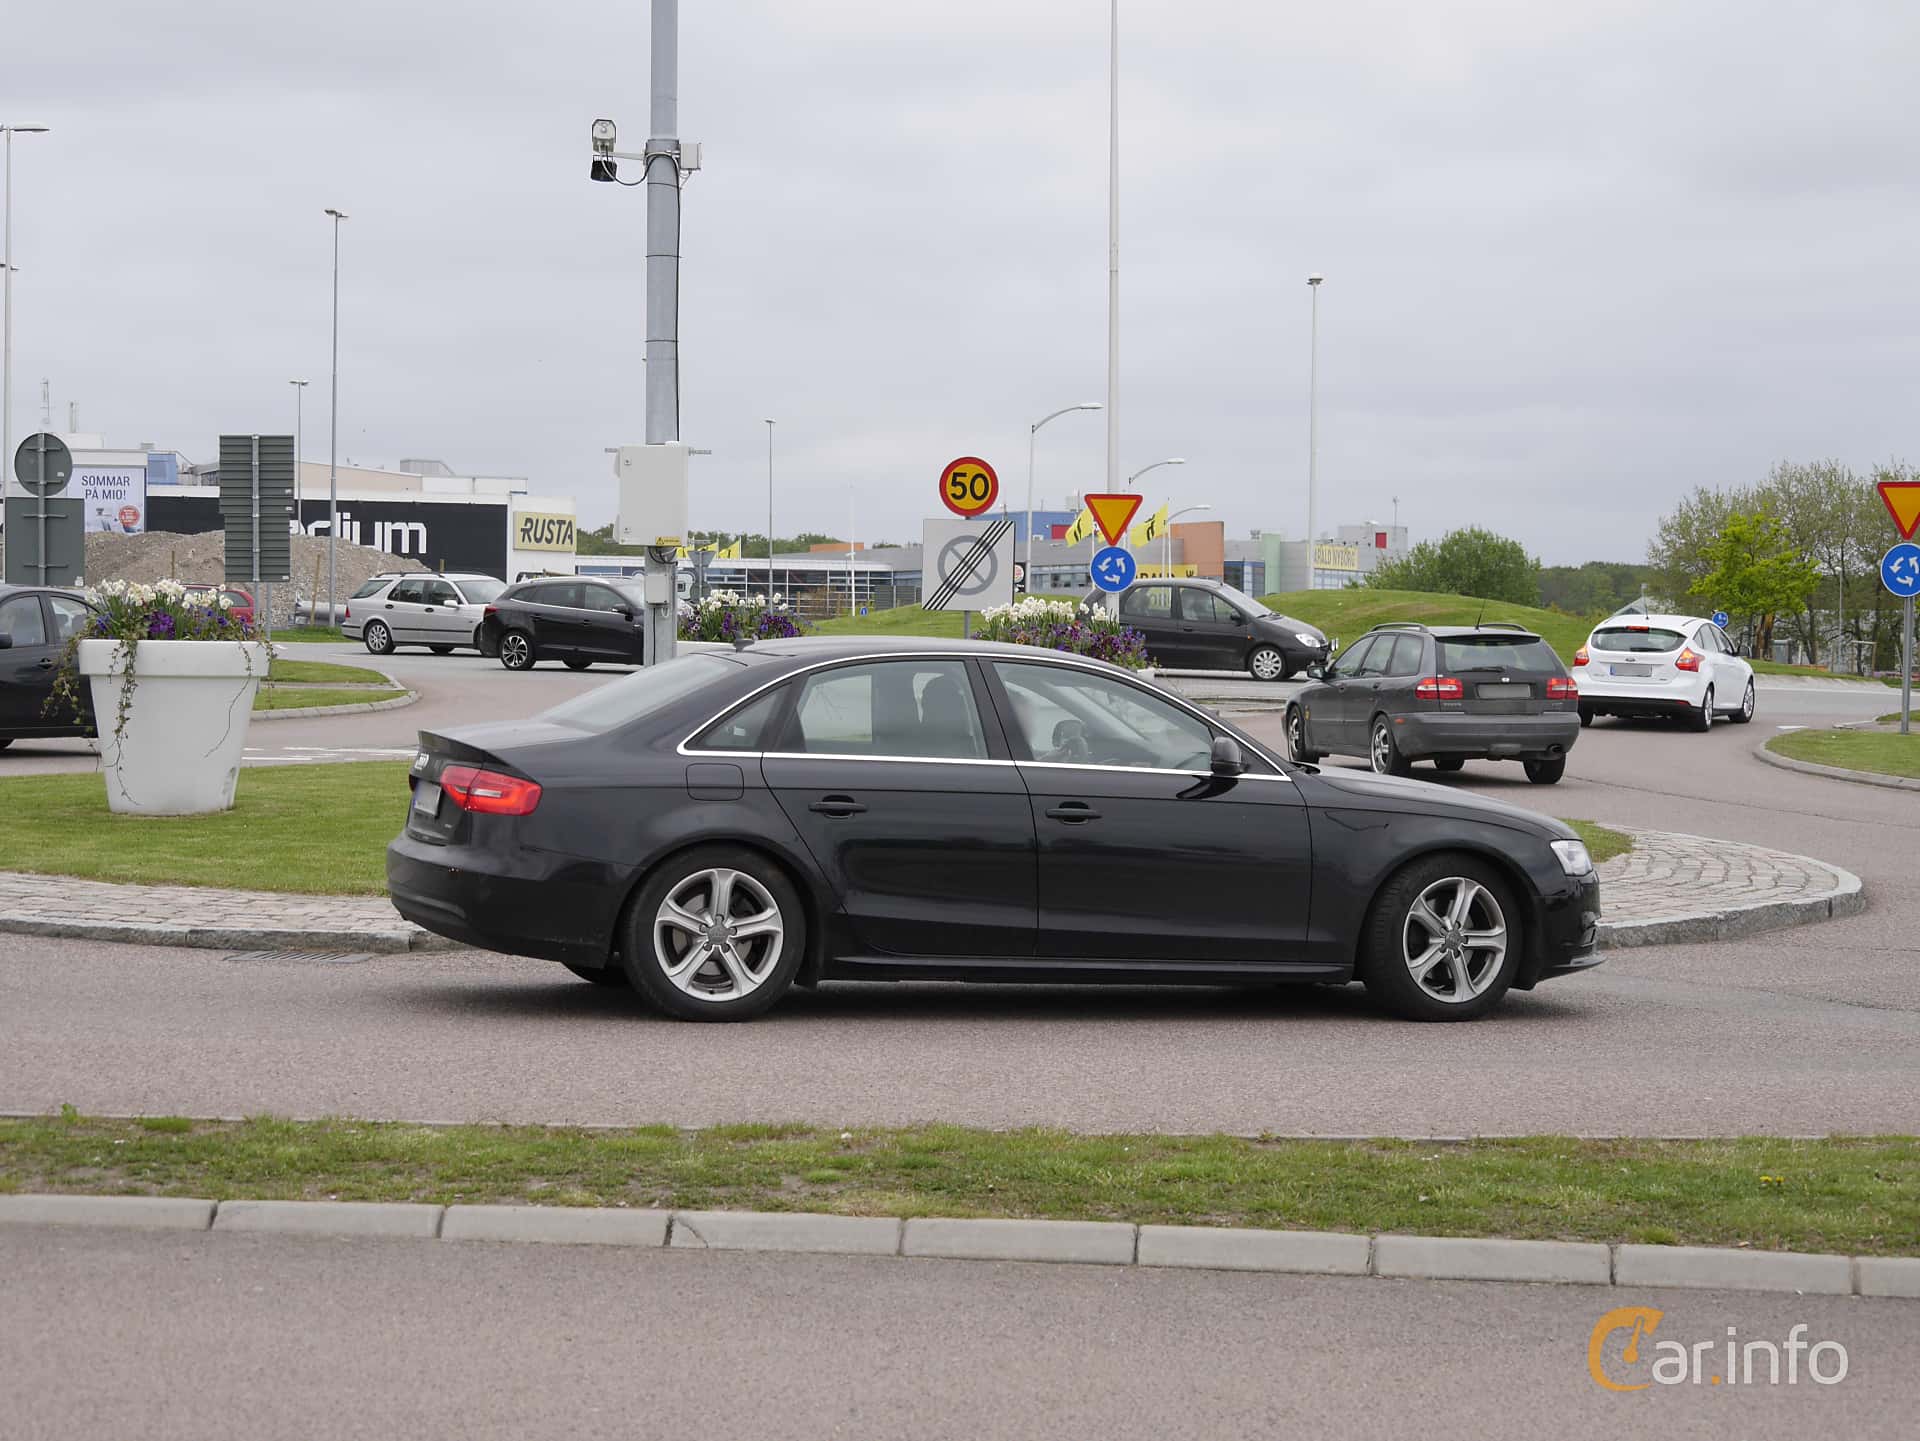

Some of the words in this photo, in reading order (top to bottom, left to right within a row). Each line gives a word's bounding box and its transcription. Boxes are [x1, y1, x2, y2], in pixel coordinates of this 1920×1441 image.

[81, 475, 130, 487] SOMMAR
[951, 472, 990, 501] 50
[85, 487, 99, 500] PÅ
[102, 489, 126, 500] MIO!
[520, 517, 574, 546] RUSTA
